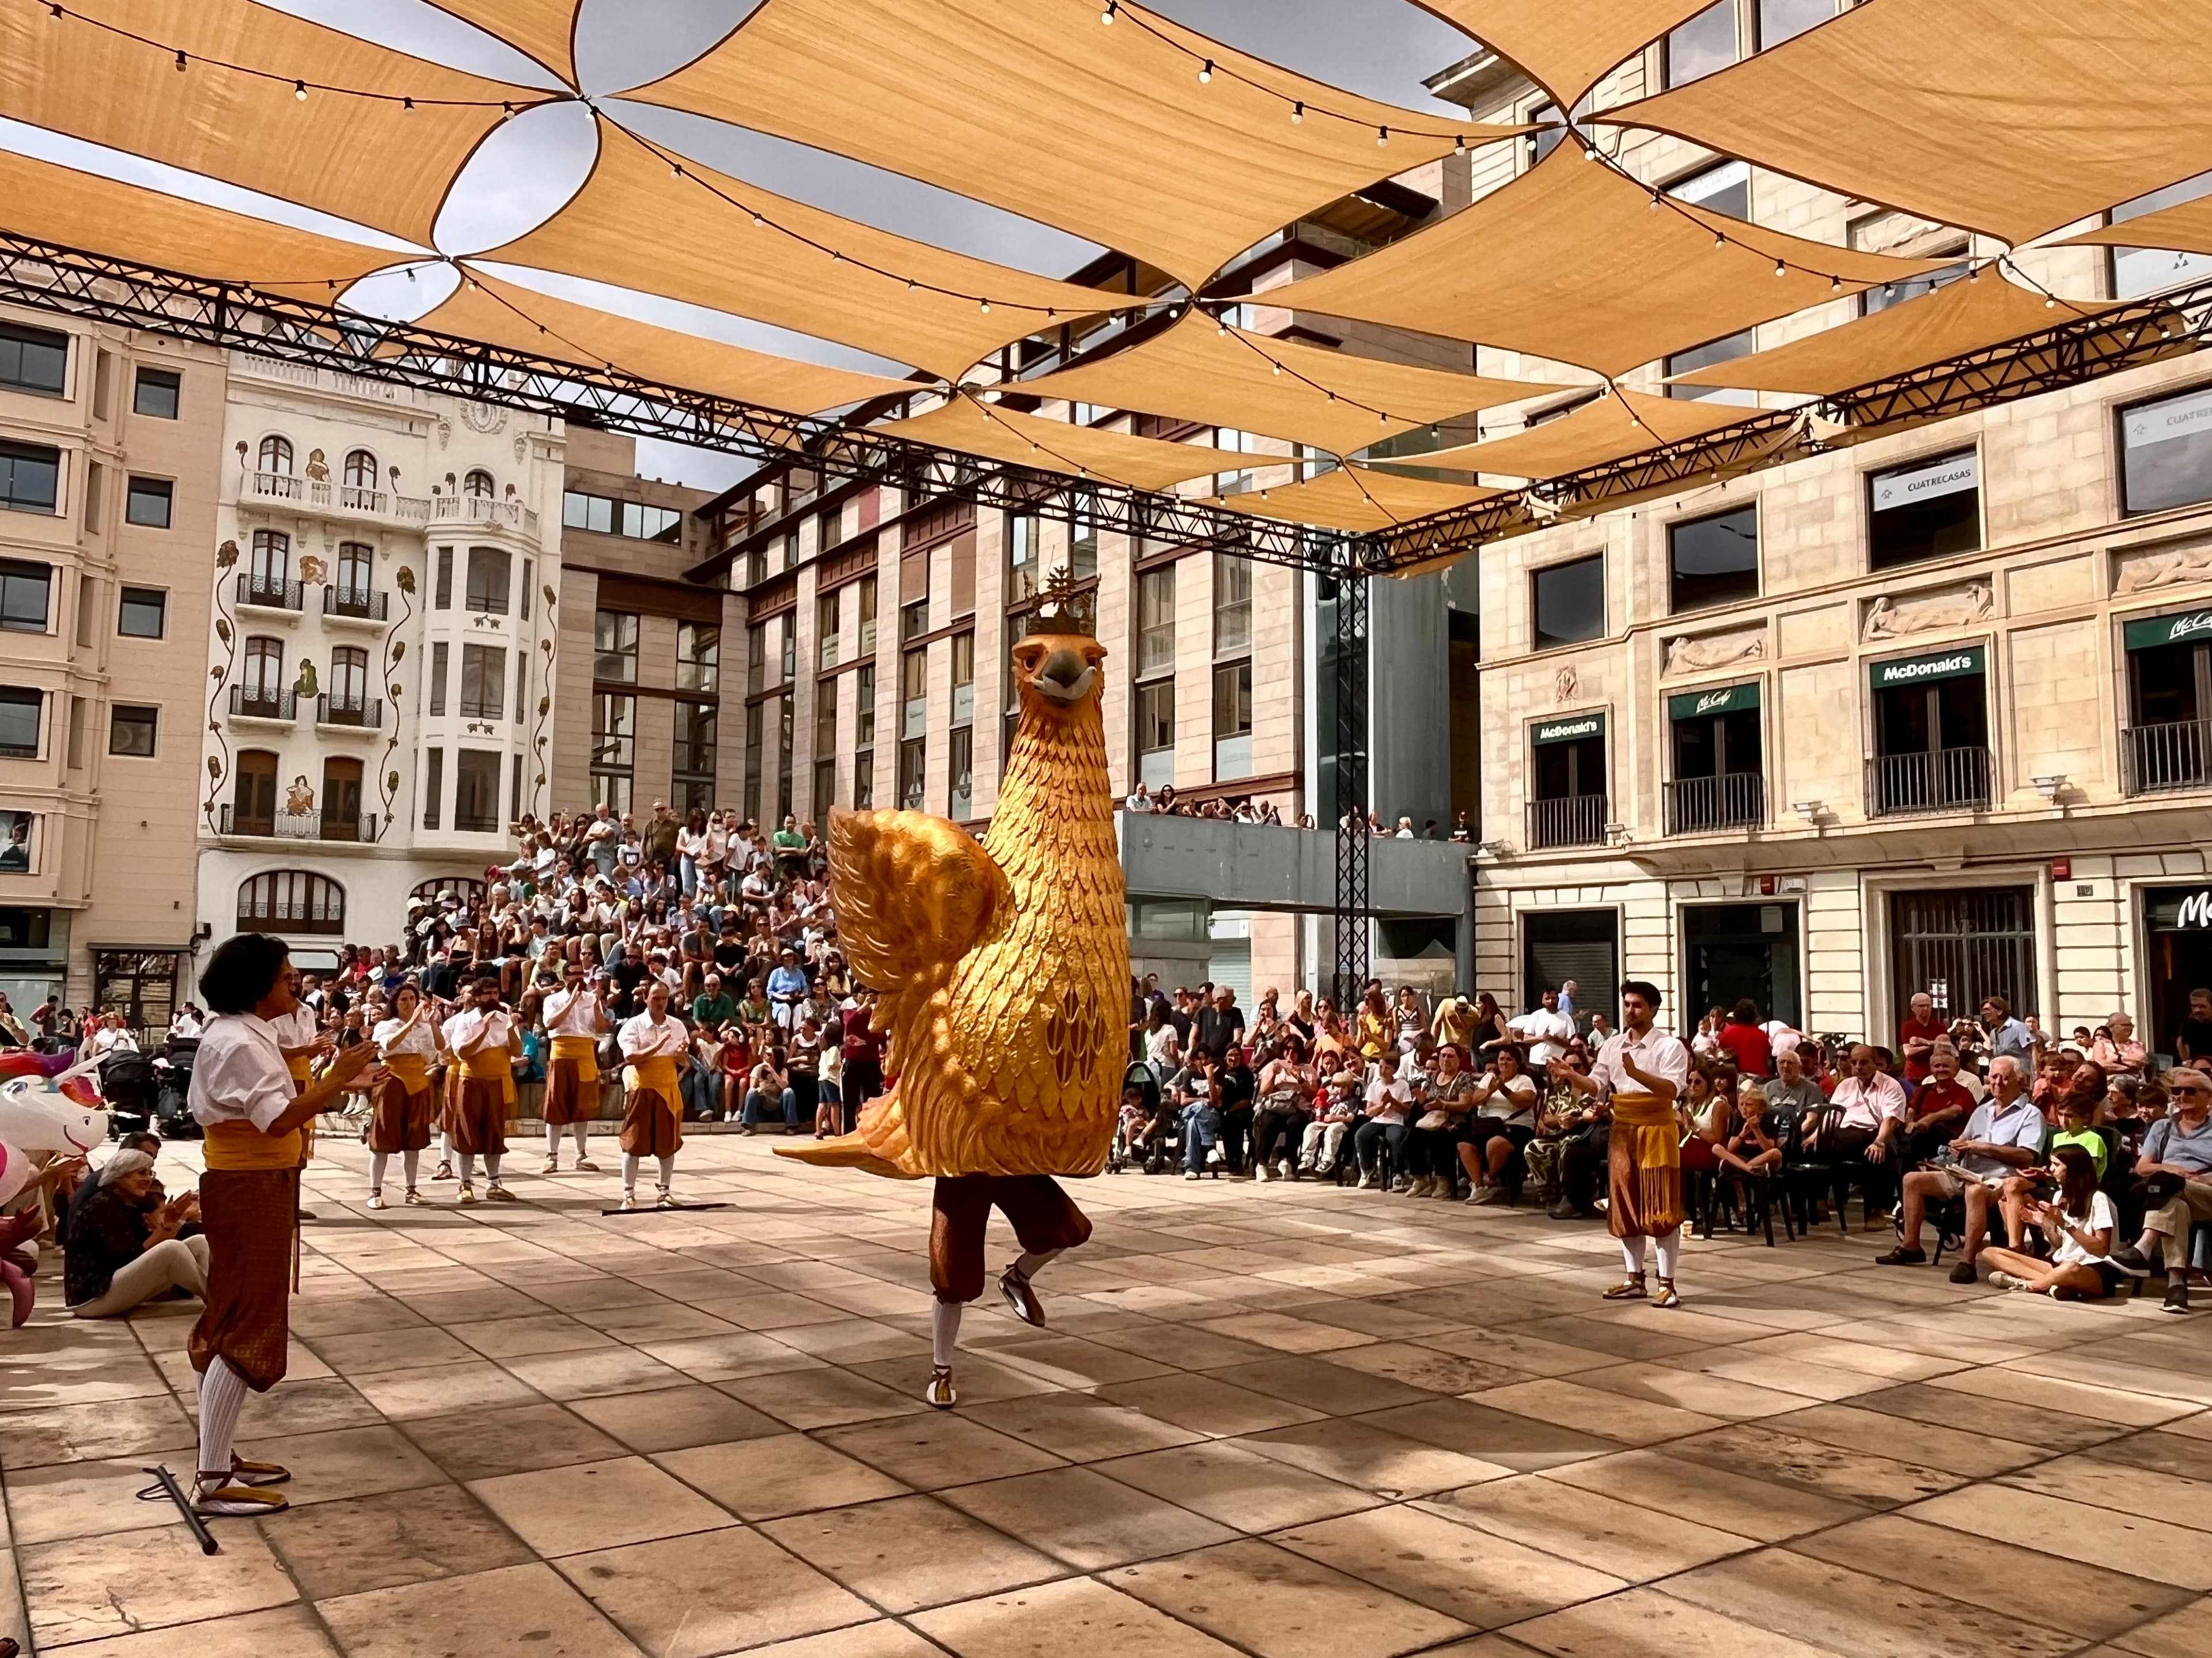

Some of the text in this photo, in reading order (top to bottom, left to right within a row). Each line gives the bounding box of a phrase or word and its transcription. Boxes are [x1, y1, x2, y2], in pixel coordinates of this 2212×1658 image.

[1908, 469, 1971, 491] CUATRECASAS
[1884, 656, 1972, 681] McDonald's
[1540, 721, 1597, 740] McDonald's
